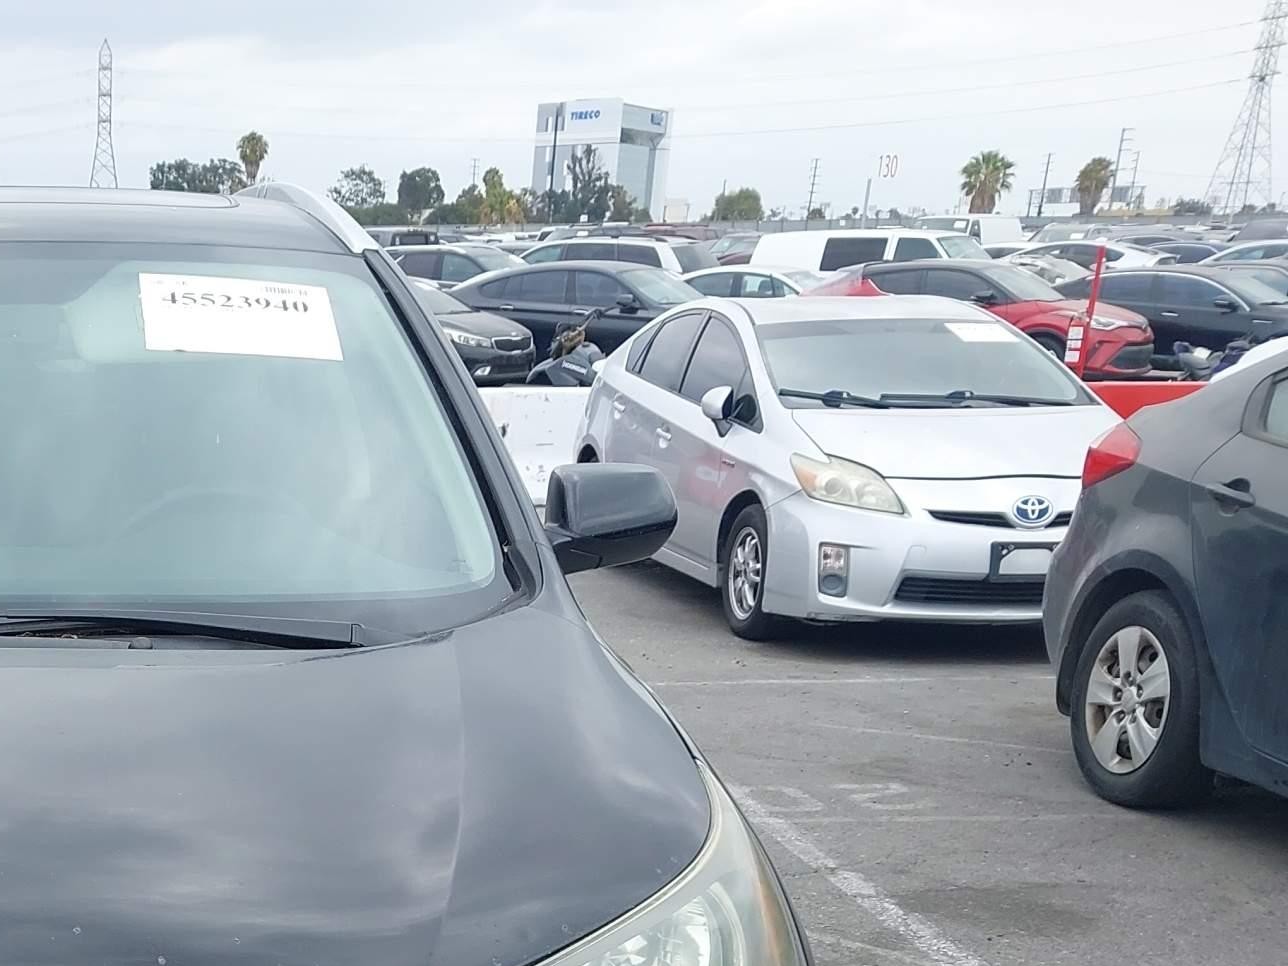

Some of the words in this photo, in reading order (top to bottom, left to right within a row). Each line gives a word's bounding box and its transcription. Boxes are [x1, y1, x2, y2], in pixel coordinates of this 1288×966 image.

[570, 109, 601, 121] TIRECO
[878, 154, 899, 178] 130
[162, 291, 309, 313] 45523940
